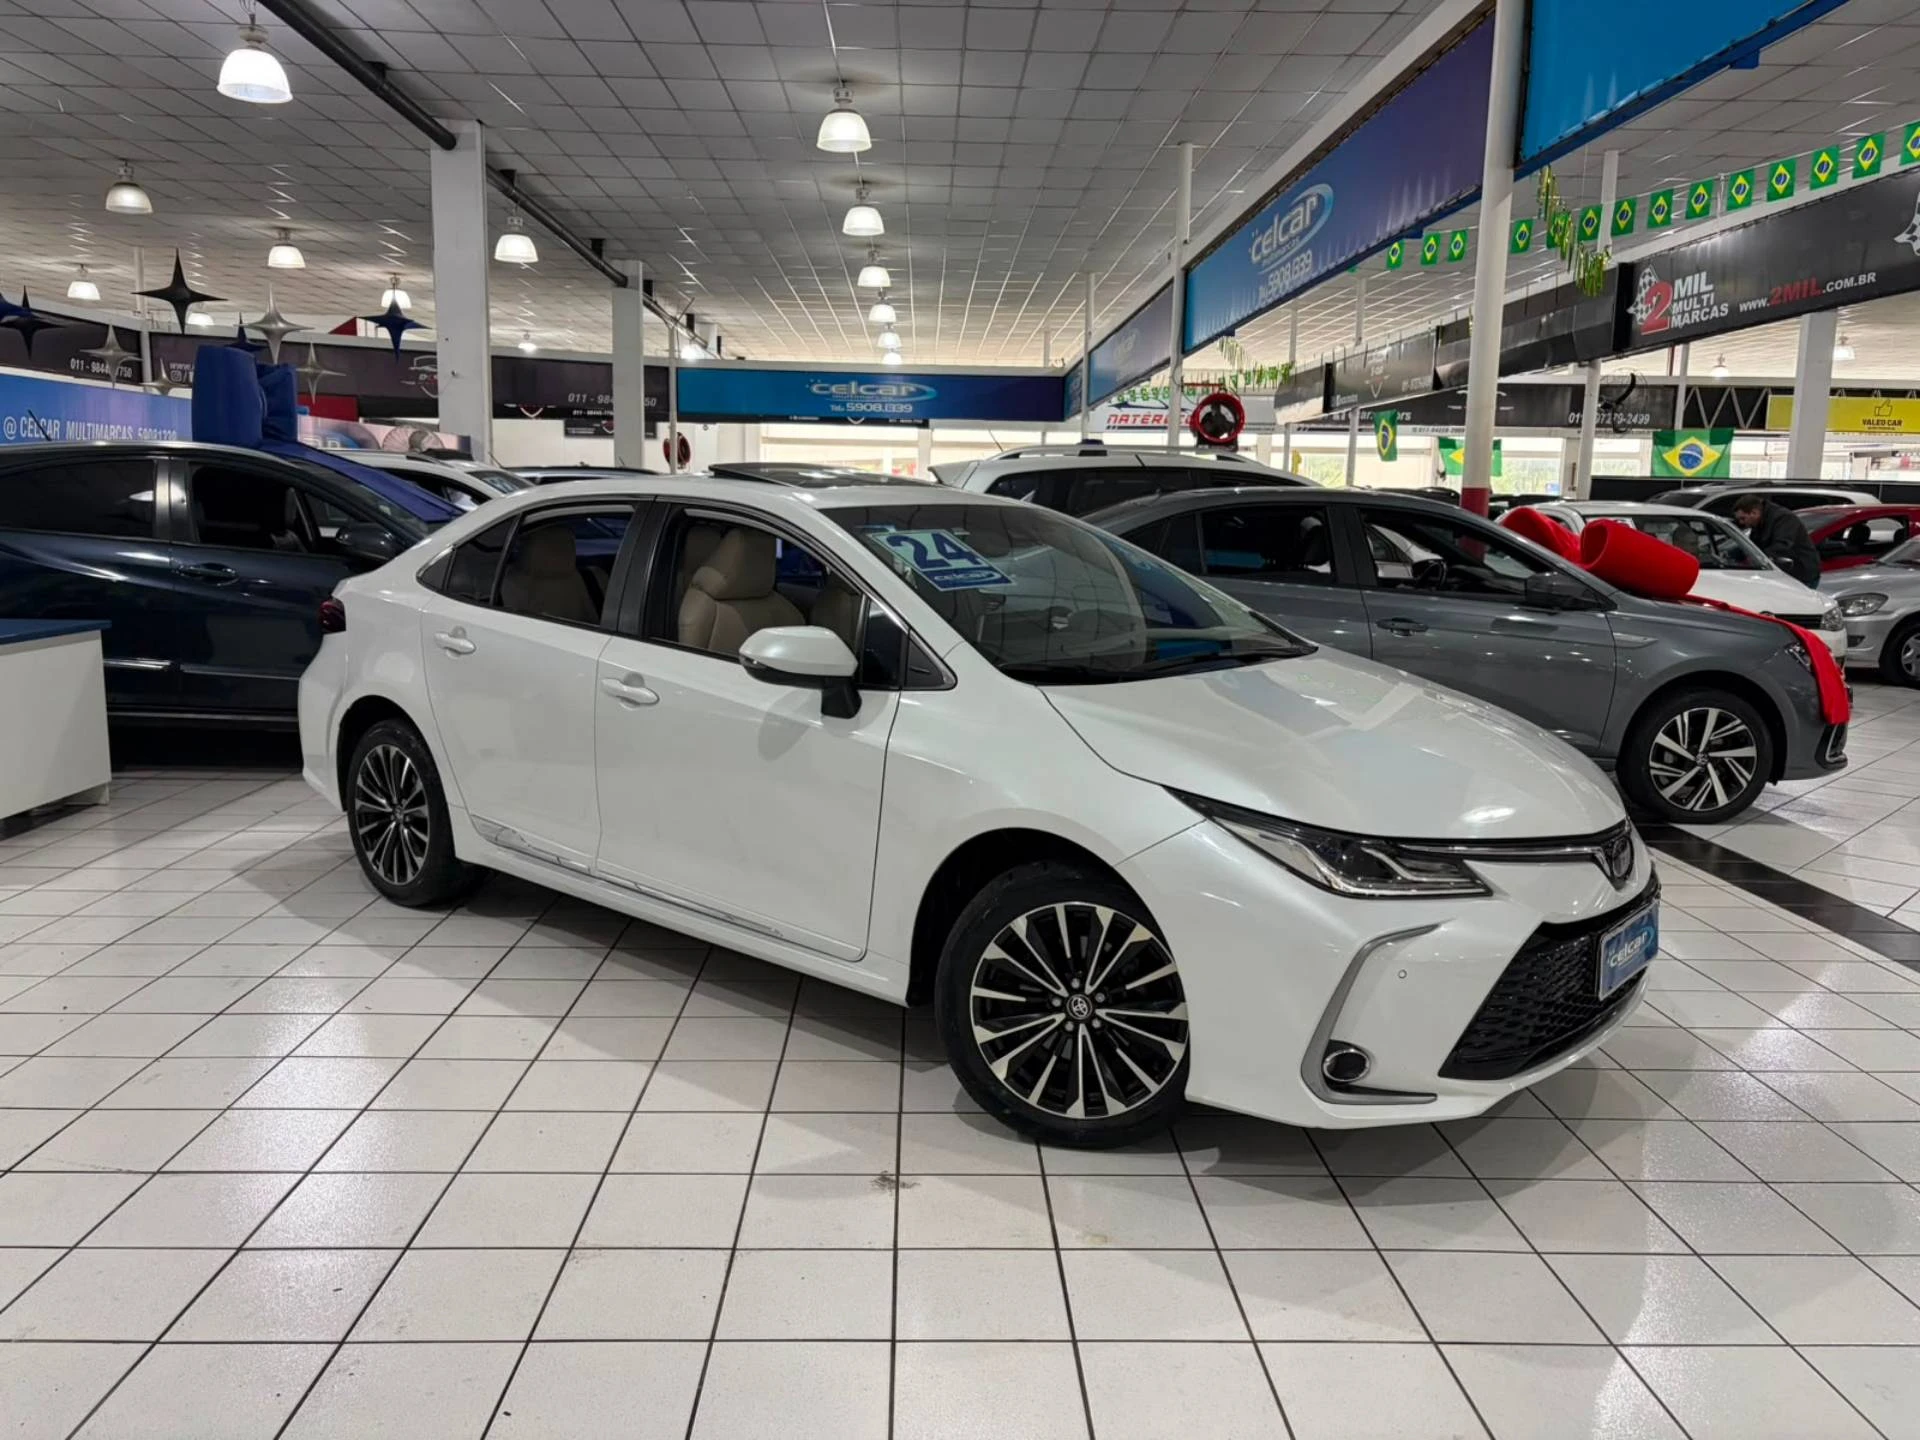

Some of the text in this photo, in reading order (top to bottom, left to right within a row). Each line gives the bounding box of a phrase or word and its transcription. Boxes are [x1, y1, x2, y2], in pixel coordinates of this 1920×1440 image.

[1673, 271, 1714, 300] MIL
[1671, 303, 1729, 330] MARCAS
[1672, 292, 1715, 314] MULTI
[811, 381, 917, 396] celcar
[886, 532, 983, 569] 24
[1610, 930, 1647, 967] celcar
